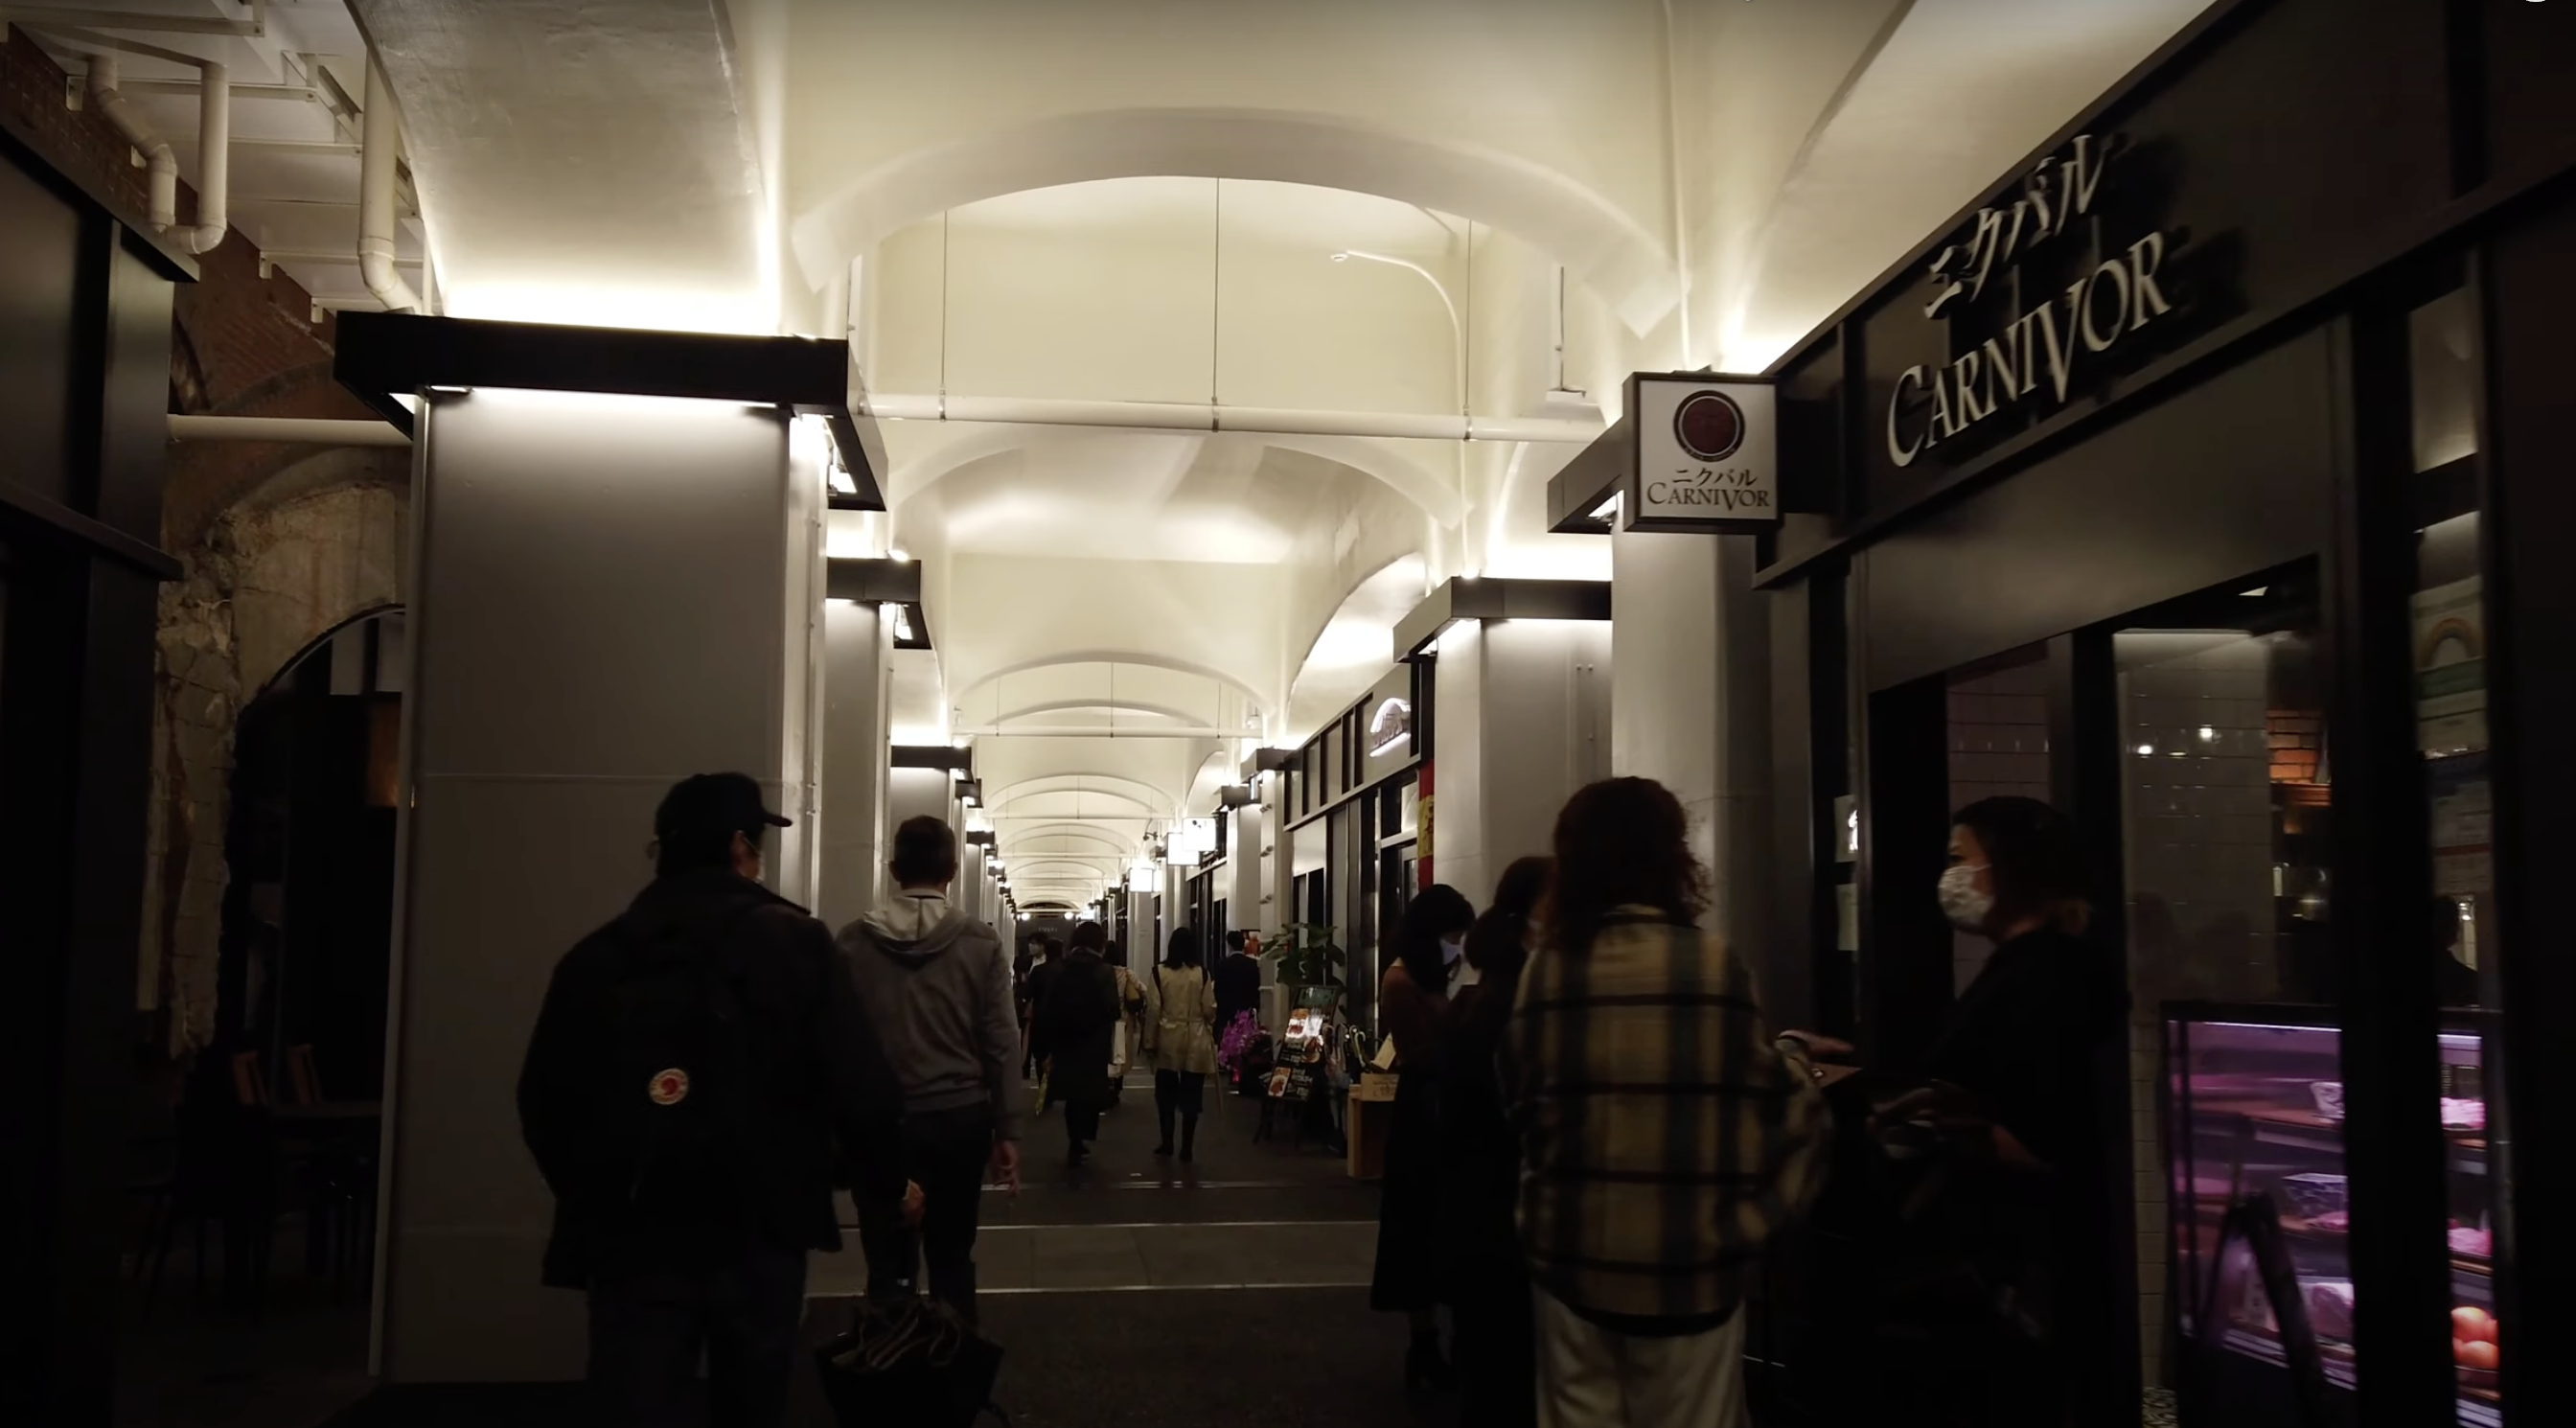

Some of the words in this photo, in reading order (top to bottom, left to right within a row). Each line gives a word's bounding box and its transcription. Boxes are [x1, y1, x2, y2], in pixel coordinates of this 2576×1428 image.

[1923, 133, 2113, 319] ニクバル
[1887, 230, 2173, 468] CARNIVOR
[1648, 482, 1770, 511] CARNIVOR
[1672, 468, 1758, 486] ニクバル
